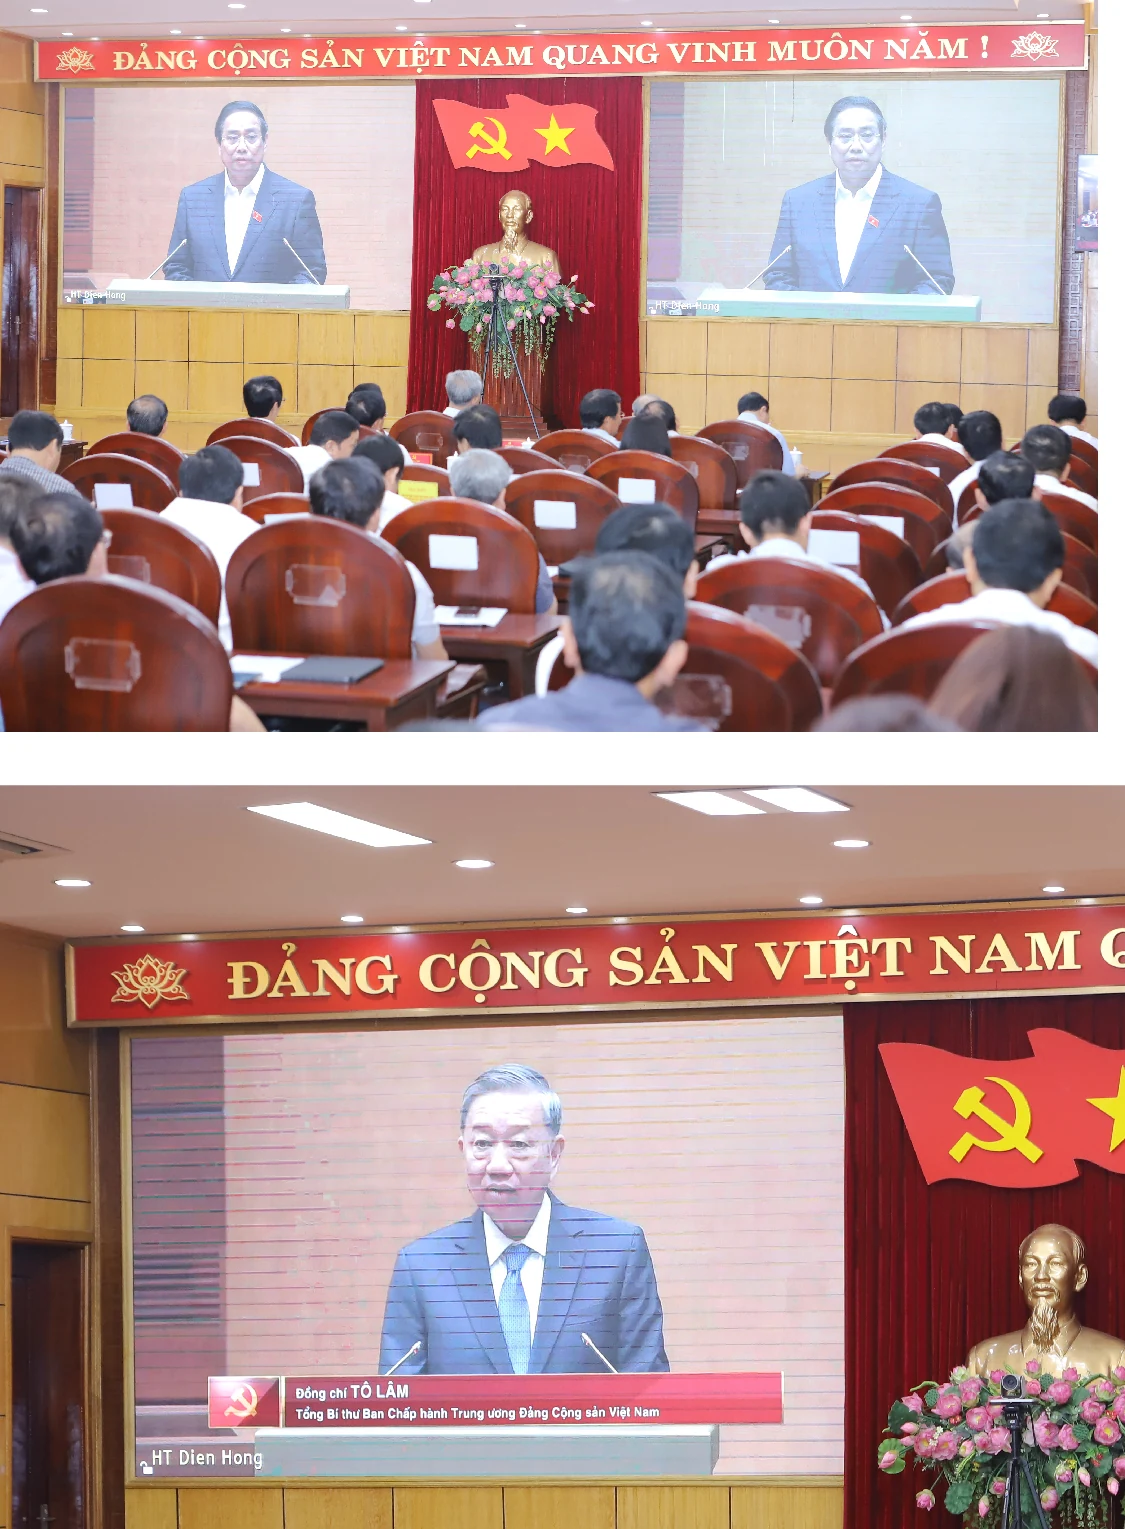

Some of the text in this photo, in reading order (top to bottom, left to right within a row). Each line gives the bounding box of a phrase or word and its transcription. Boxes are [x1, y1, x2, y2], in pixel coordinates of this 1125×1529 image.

[113, 30, 988, 75] ĐẢNG CỘNG SẢN VIỆT NAM QUANG VINH MUÔN NĂM !
[71, 291, 81, 299] HT
[106, 291, 126, 301] Hong
[656, 301, 668, 309] HT
[696, 302, 720, 312] Hong
[227, 943, 398, 1000] ĐẢNG
[419, 939, 588, 1003] CỘNG
[609, 927, 735, 988] SẢN
[755, 924, 912, 992] VIỆT
[929, 931, 1082, 976] NAM
[296, 1381, 409, 1400] Đồng chí TÔ LÂM
[296, 1405, 660, 1421] Tổng Bí thư Ban Chấp hành Trung ương Đảng Cộng sản Việt Nam
[152, 1450, 263, 1469] HT Dien Hong
